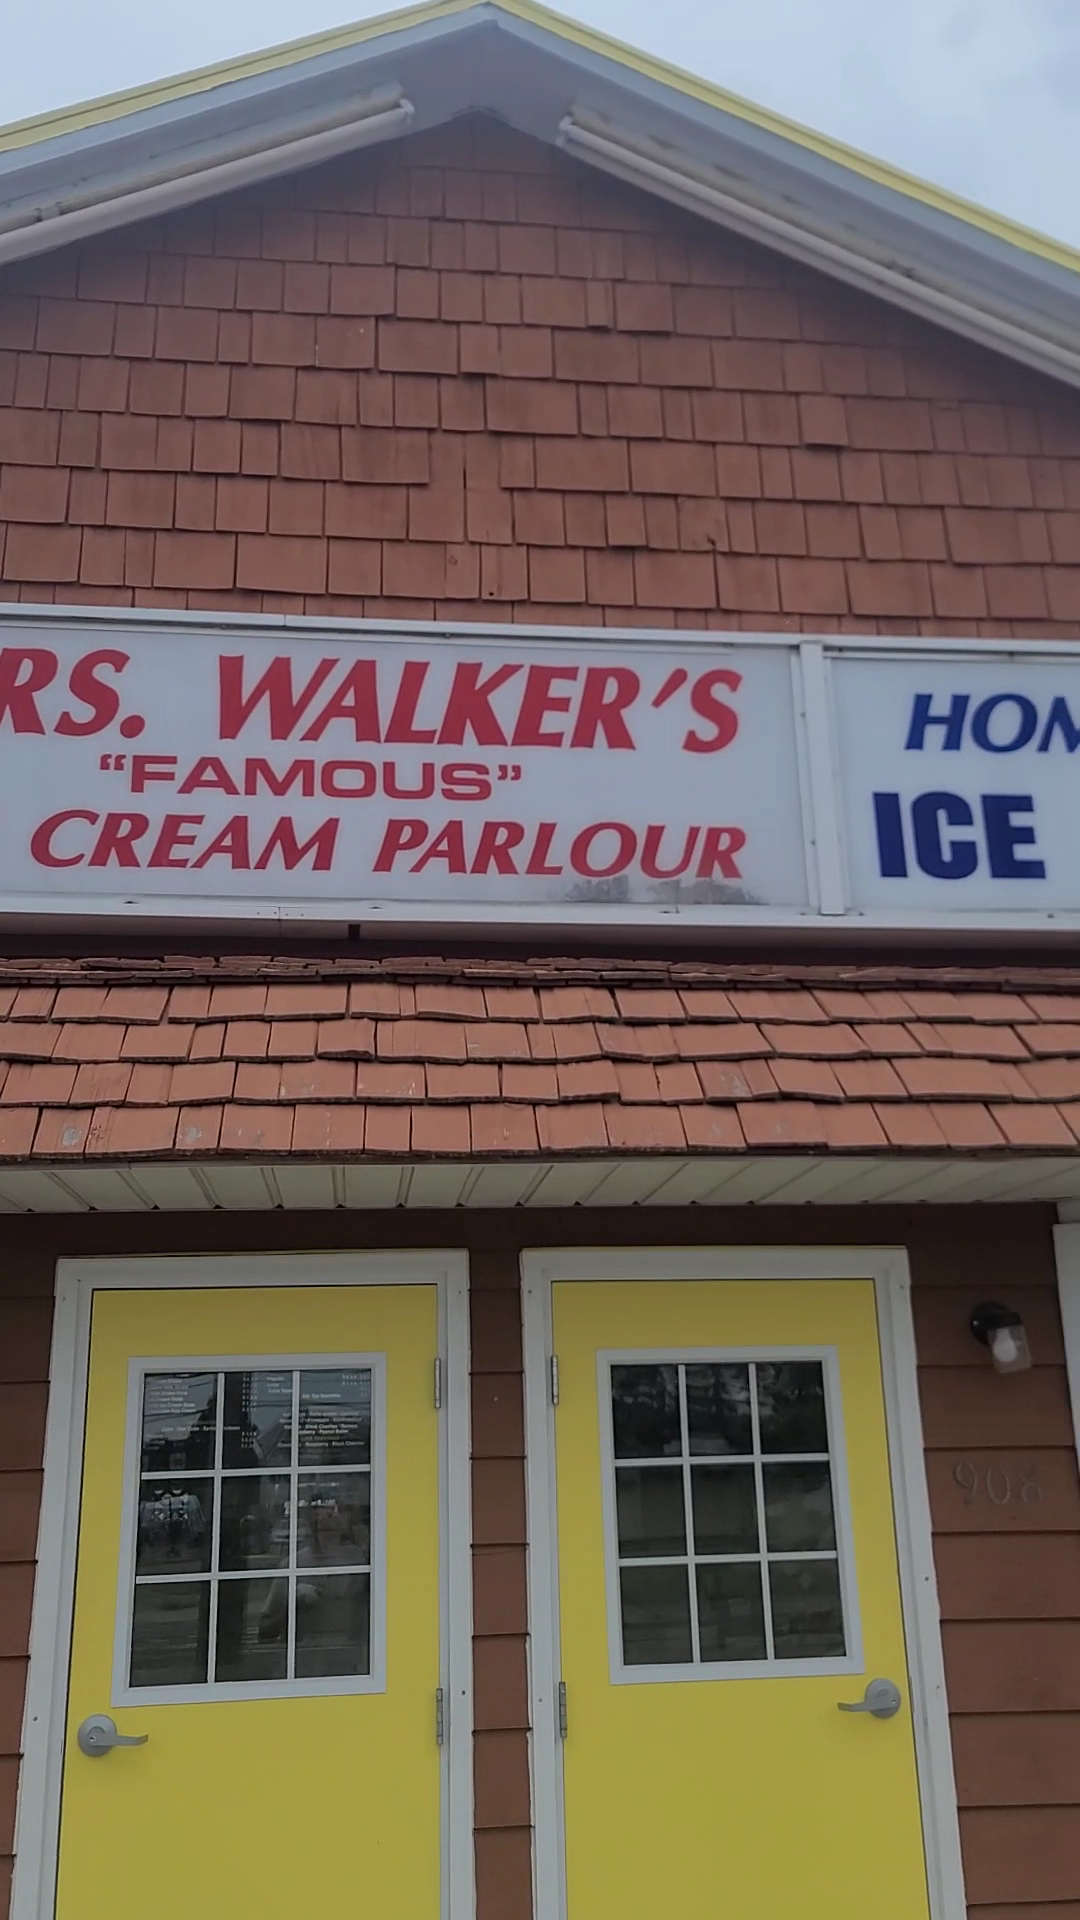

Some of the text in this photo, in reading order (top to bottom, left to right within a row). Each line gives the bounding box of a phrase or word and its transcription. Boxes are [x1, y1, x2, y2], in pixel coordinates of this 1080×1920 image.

[218, 654, 743, 754] WALKER'S
[100, 754, 522, 801] “FAMOUS”
[30, 809, 747, 880] CREAM PARLOUR
[872, 790, 1047, 881] ICE
